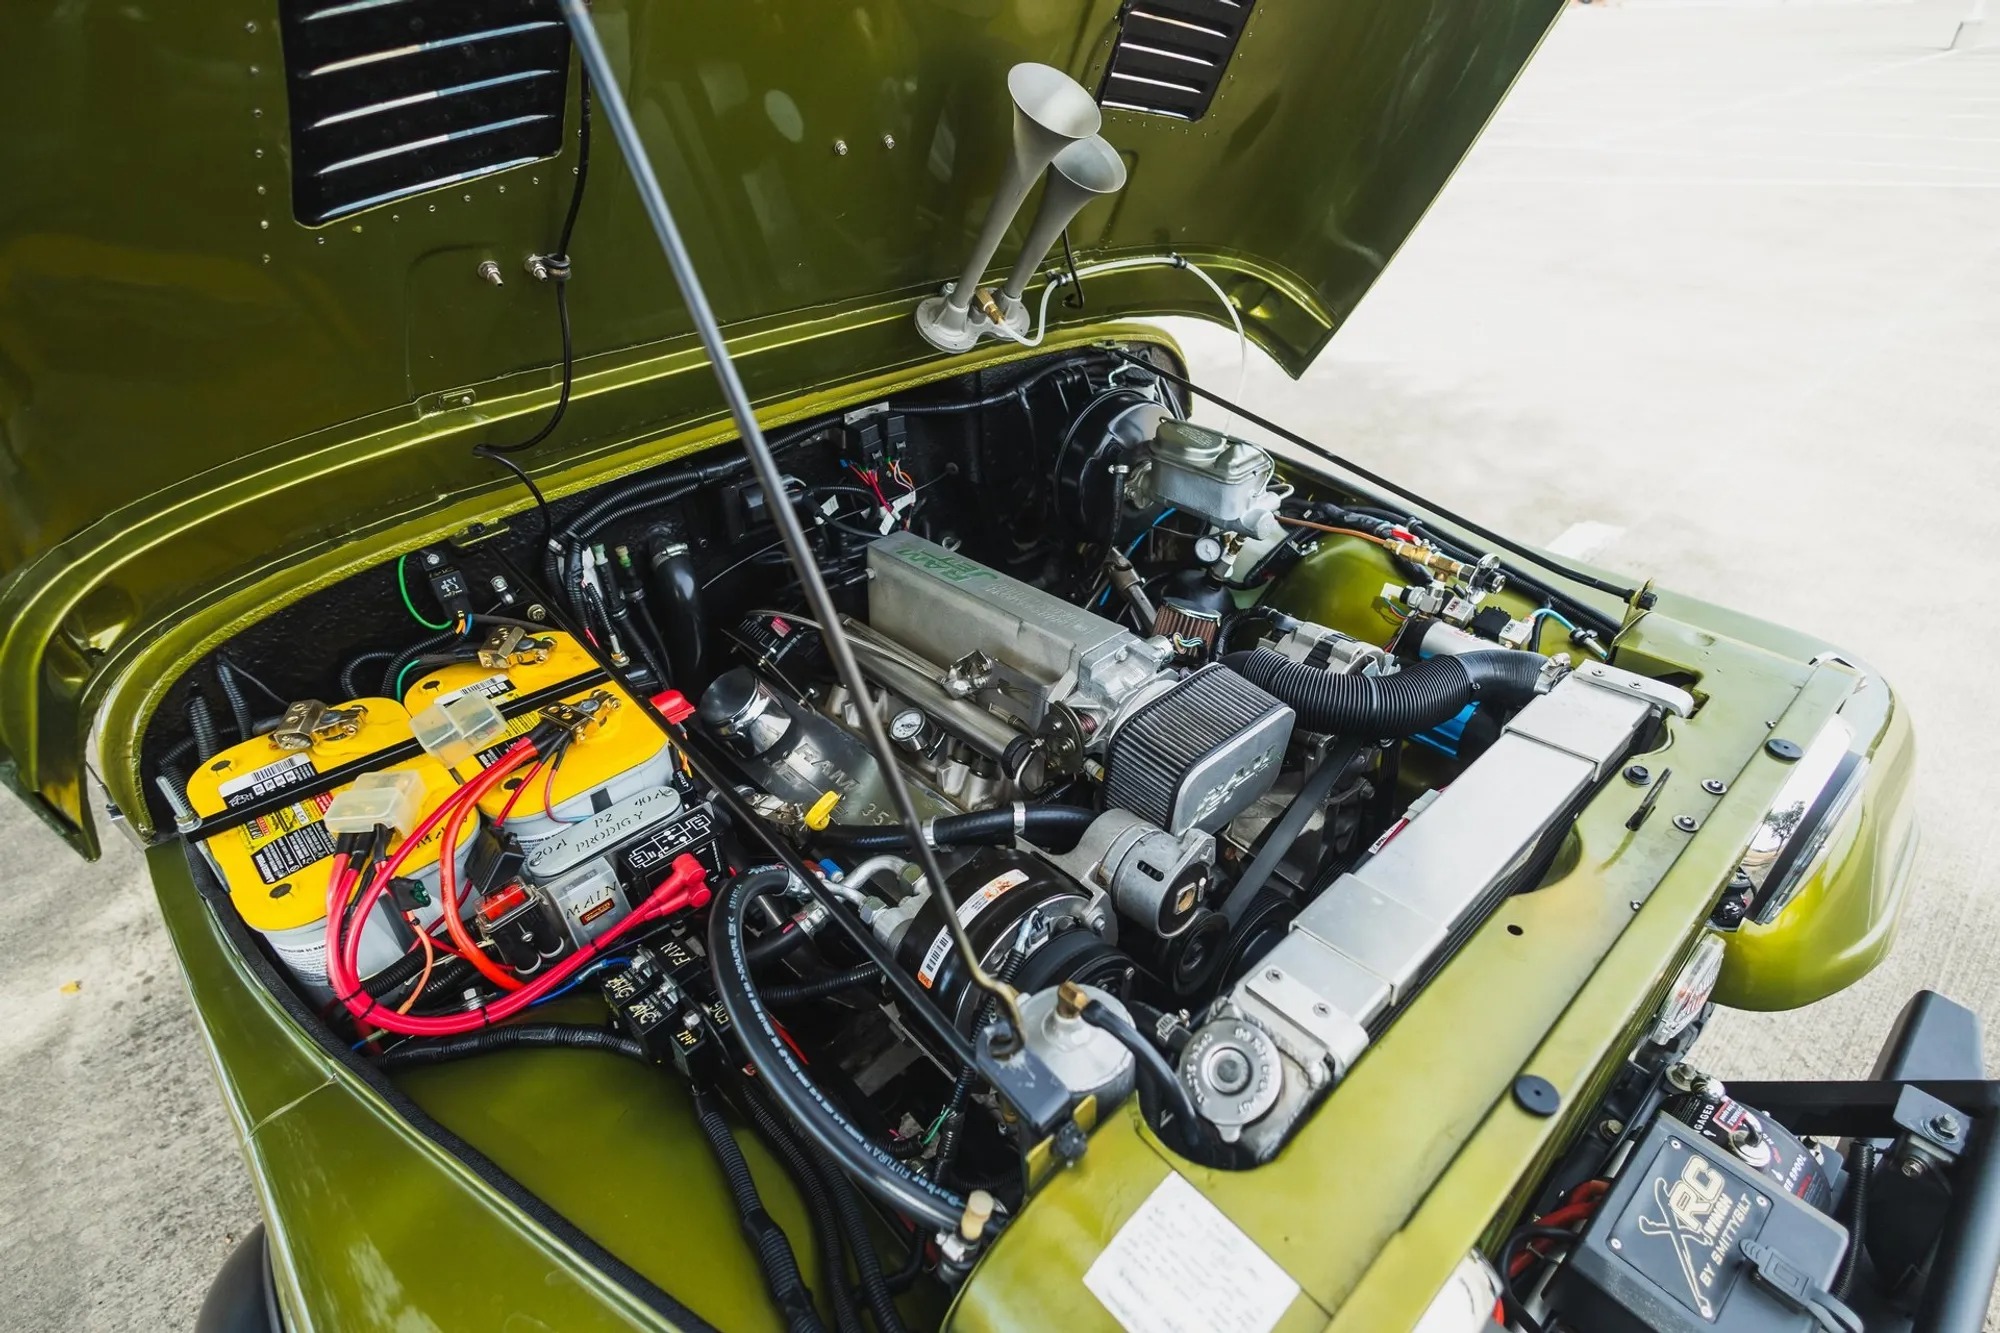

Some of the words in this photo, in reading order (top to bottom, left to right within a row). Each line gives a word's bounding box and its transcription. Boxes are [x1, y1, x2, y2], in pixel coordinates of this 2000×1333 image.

[897, 549, 968, 582] RAM
[919, 549, 999, 581] JET
[793, 741, 860, 791] RAM
[575, 811, 643, 853] PRODIGY
[566, 881, 617, 919] MAIN
[660, 942, 691, 965] FAN
[1694, 1103, 1715, 1134] GAGED
[872, 1147, 912, 1179] FUTURA
[1790, 1154, 1807, 1182] SPOOL
[1699, 1262, 1716, 1287] BY
[1711, 1193, 1751, 1266] SMITTYBILT
